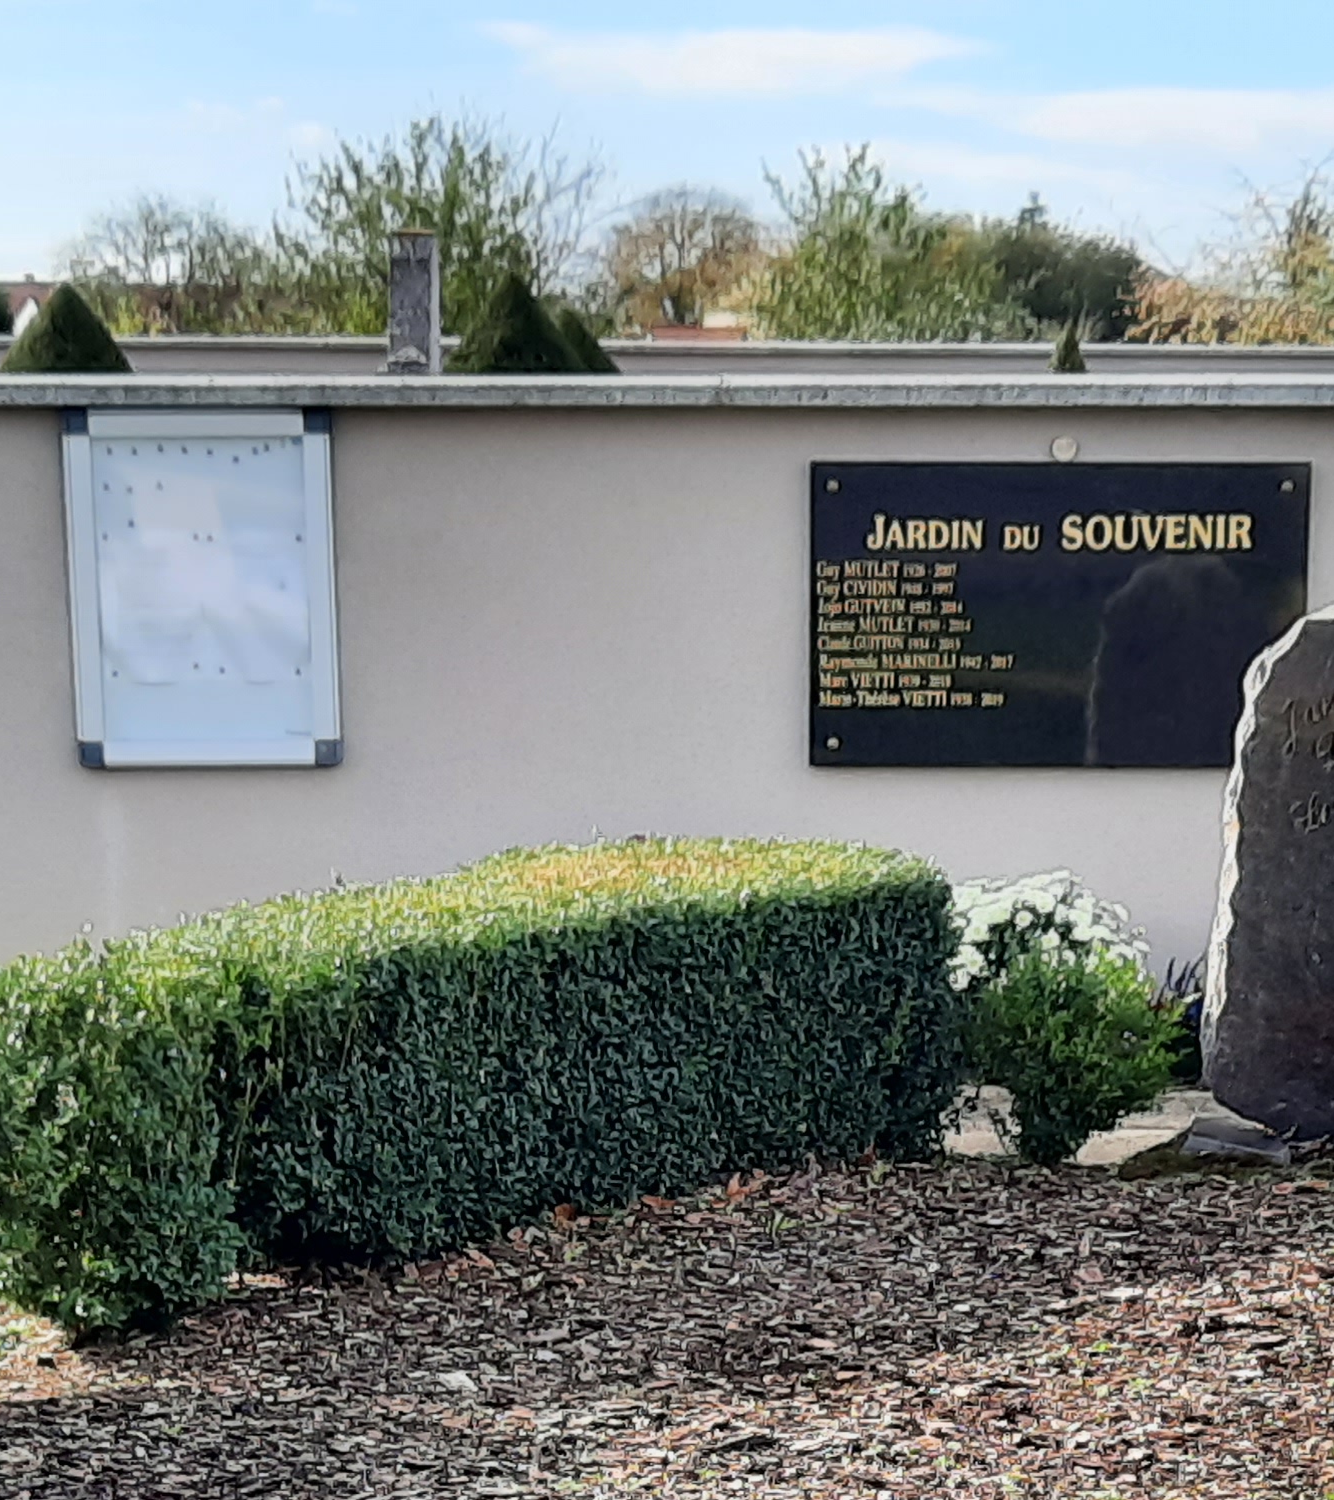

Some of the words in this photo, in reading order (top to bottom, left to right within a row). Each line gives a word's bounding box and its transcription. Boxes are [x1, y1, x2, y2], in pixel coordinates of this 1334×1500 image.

[867, 514, 984, 550] JARDIN
[1004, 523, 1040, 549] DU
[1061, 512, 1252, 549] SOUVENIR
[844, 560, 900, 577] MUTLET
[843, 580, 896, 595] CIVIDIN
[859, 616, 914, 632] MUTLET
[882, 653, 956, 669] MARINELLI
[851, 672, 895, 688] VIETTI
[903, 691, 947, 706] VIETTI
